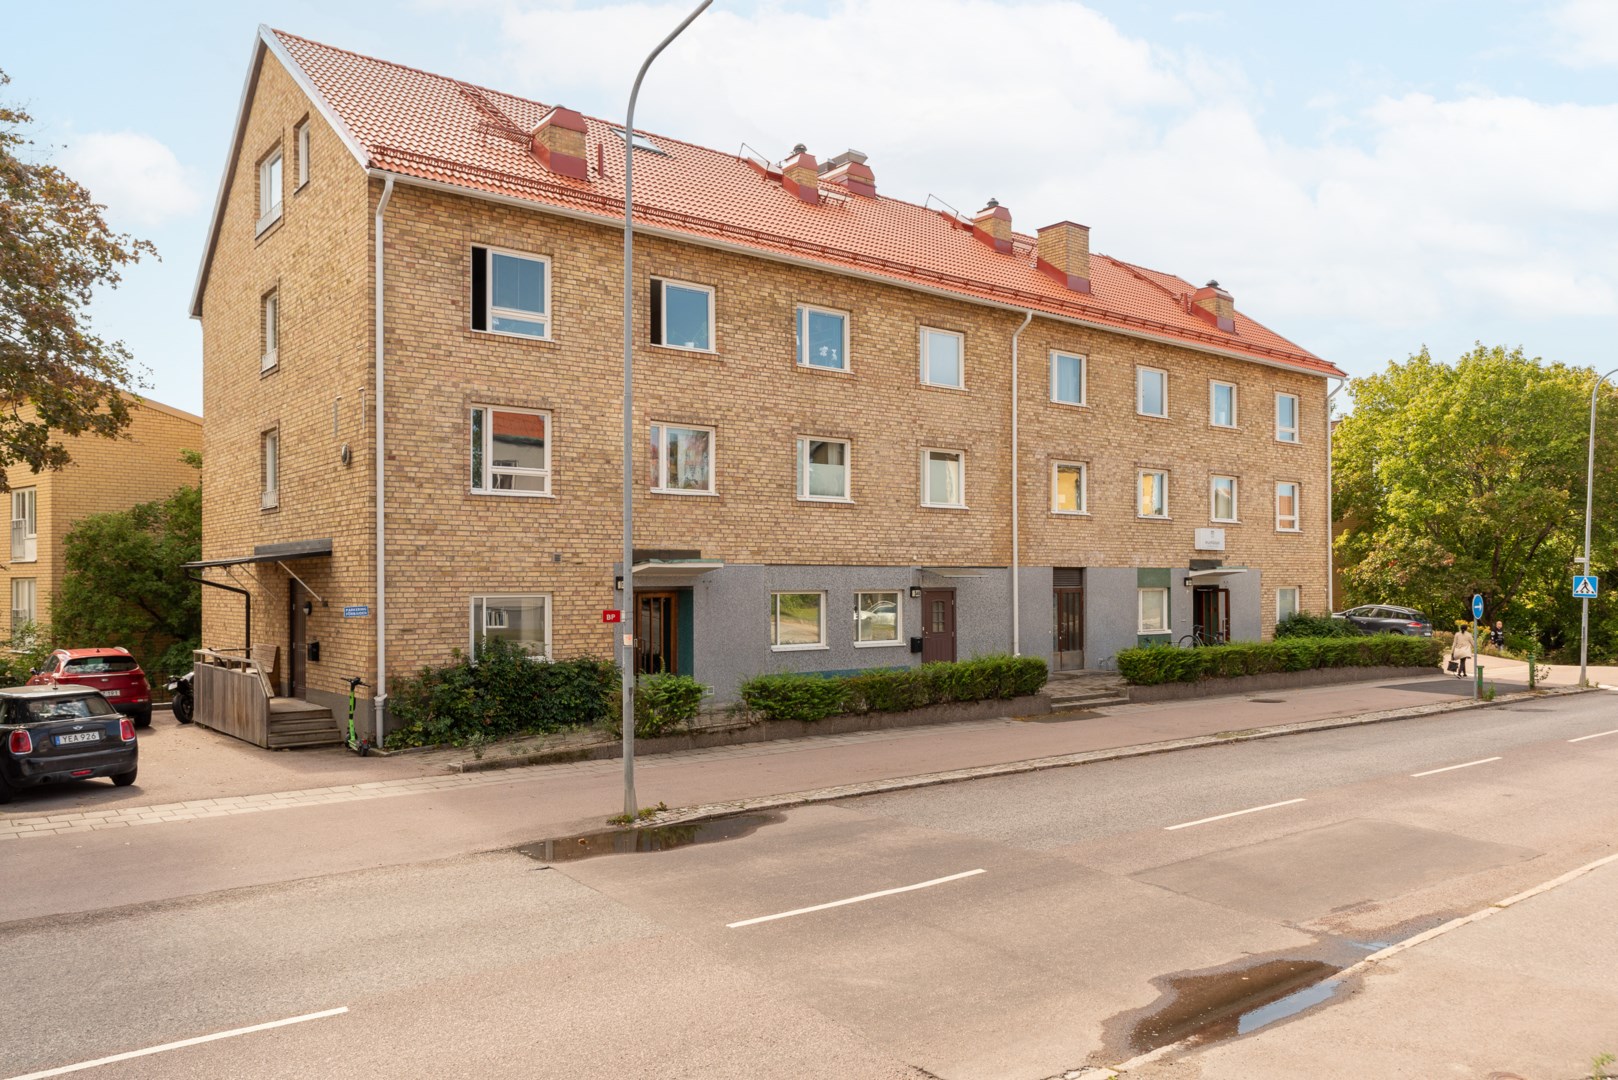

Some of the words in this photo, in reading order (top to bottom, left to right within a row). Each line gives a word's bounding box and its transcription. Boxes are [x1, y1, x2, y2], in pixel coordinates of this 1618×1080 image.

[606, 613, 616, 621] BP
[62, 734, 80, 742] YEA
[80, 733, 97, 741] 926
